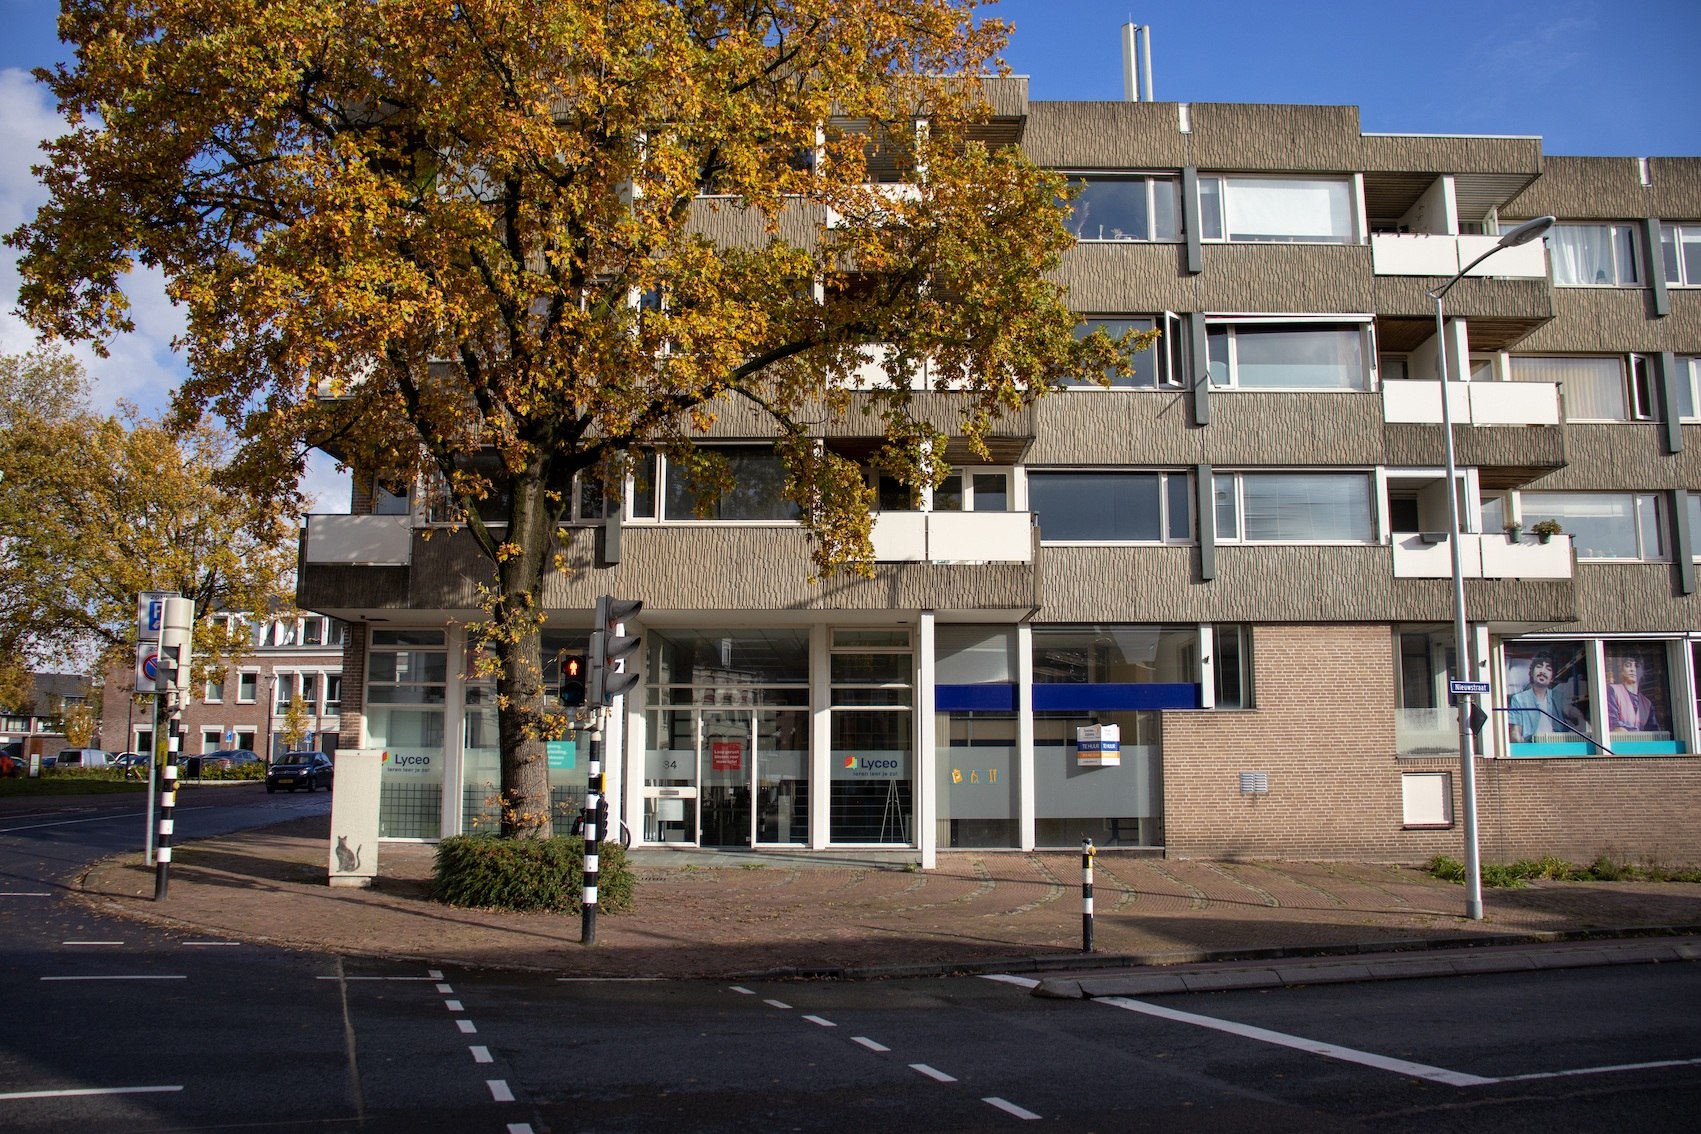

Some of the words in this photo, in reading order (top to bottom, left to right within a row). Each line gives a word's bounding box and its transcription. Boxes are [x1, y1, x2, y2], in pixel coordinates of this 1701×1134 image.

[1454, 683, 1487, 692] Nieuwstraat
[395, 753, 430, 767] Lyceo
[663, 760, 677, 769] 34
[861, 757, 898, 771] Lyceo
